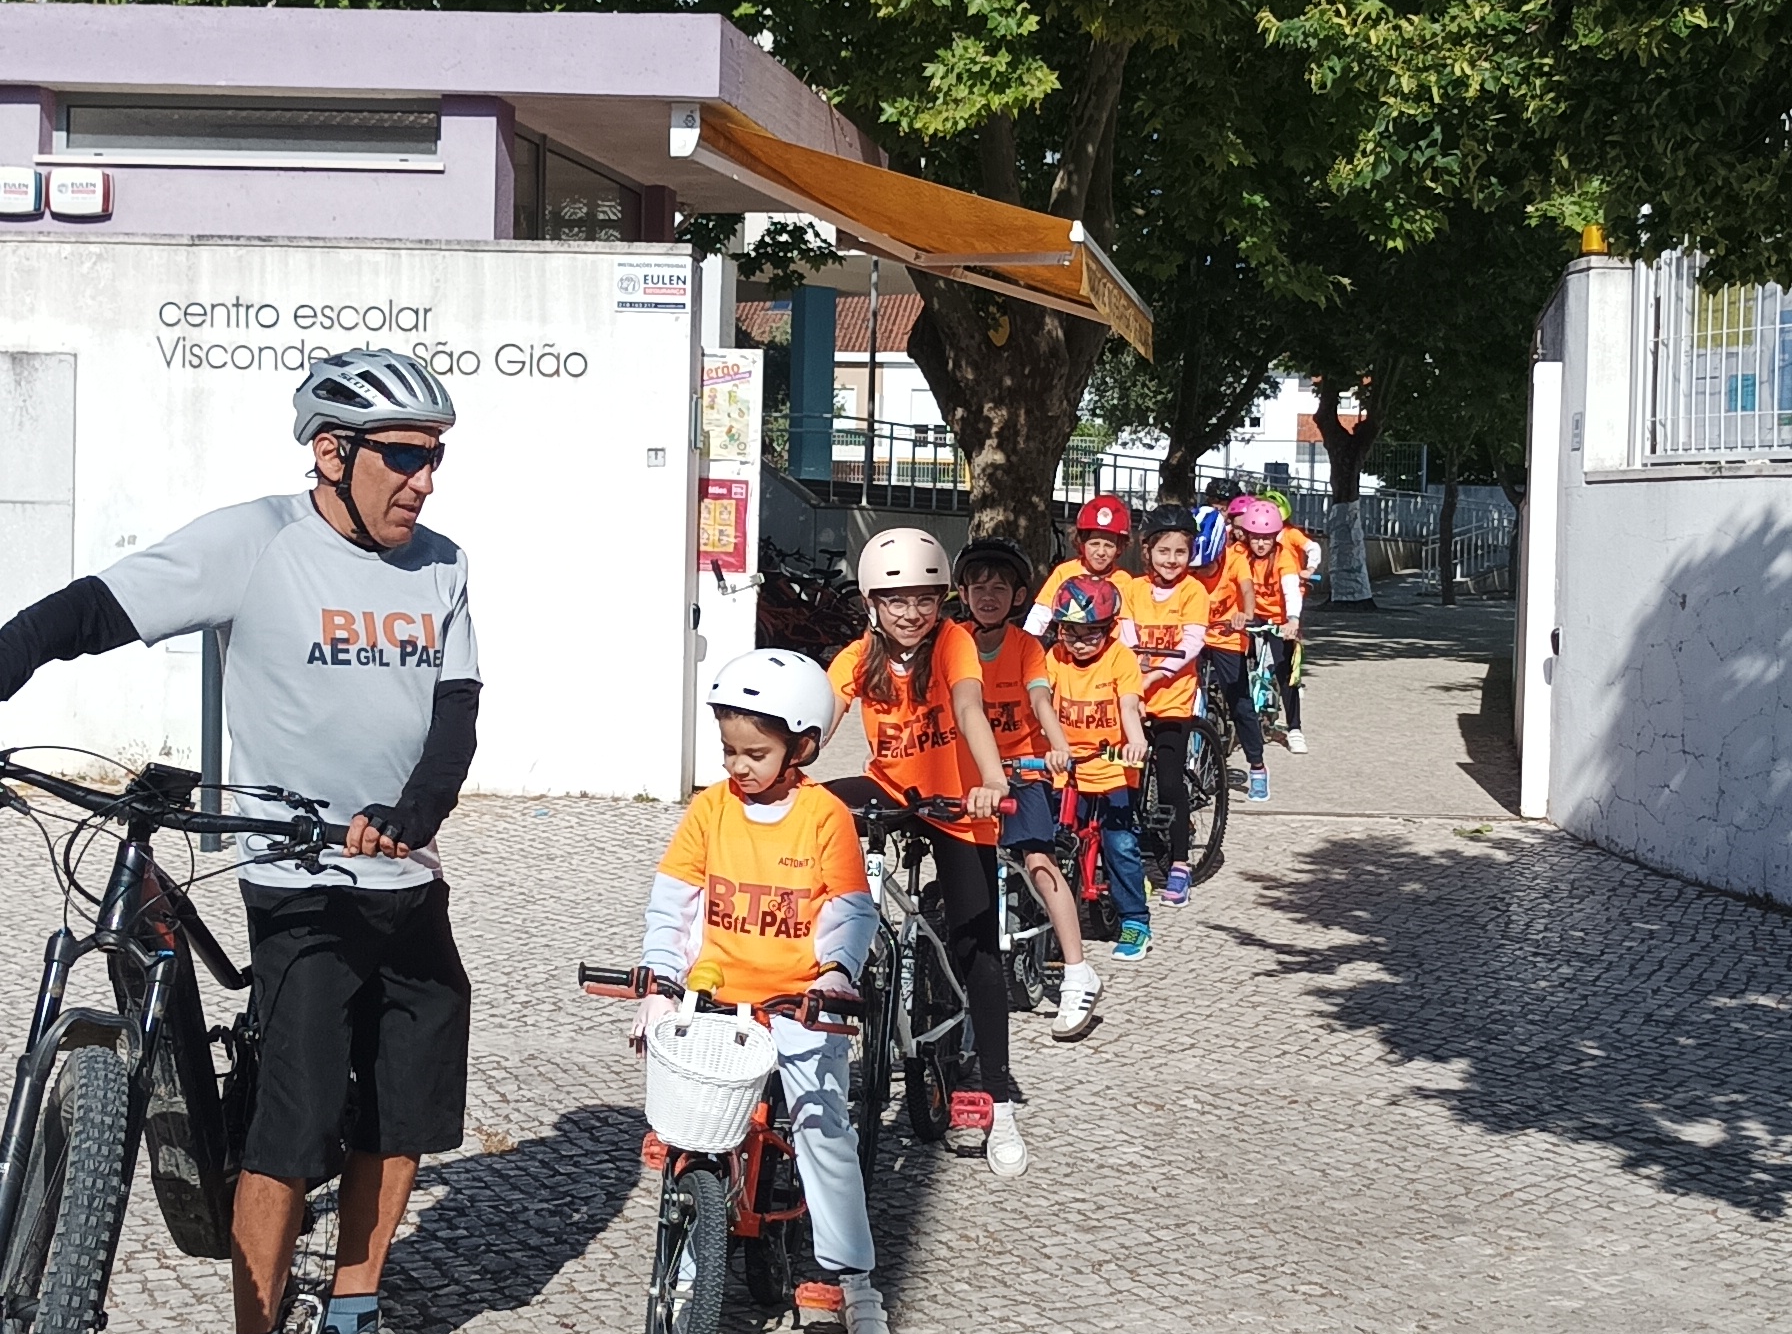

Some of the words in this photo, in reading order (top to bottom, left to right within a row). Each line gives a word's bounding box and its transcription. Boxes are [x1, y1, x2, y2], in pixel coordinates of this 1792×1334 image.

[643, 274, 686, 285] EULEN
[159, 296, 279, 328] centro
[293, 299, 432, 332] escolar
[156, 336, 331, 371] Visconde
[412, 341, 480, 375] São
[495, 343, 588, 378] Gião
[703, 361, 740, 382] erão
[322, 608, 436, 649] BICI
[399, 639, 441, 667] PAE
[878, 704, 945, 751] BTT
[917, 727, 957, 753] PAES
[708, 874, 811, 930] BTT
[759, 911, 811, 938] PAES
